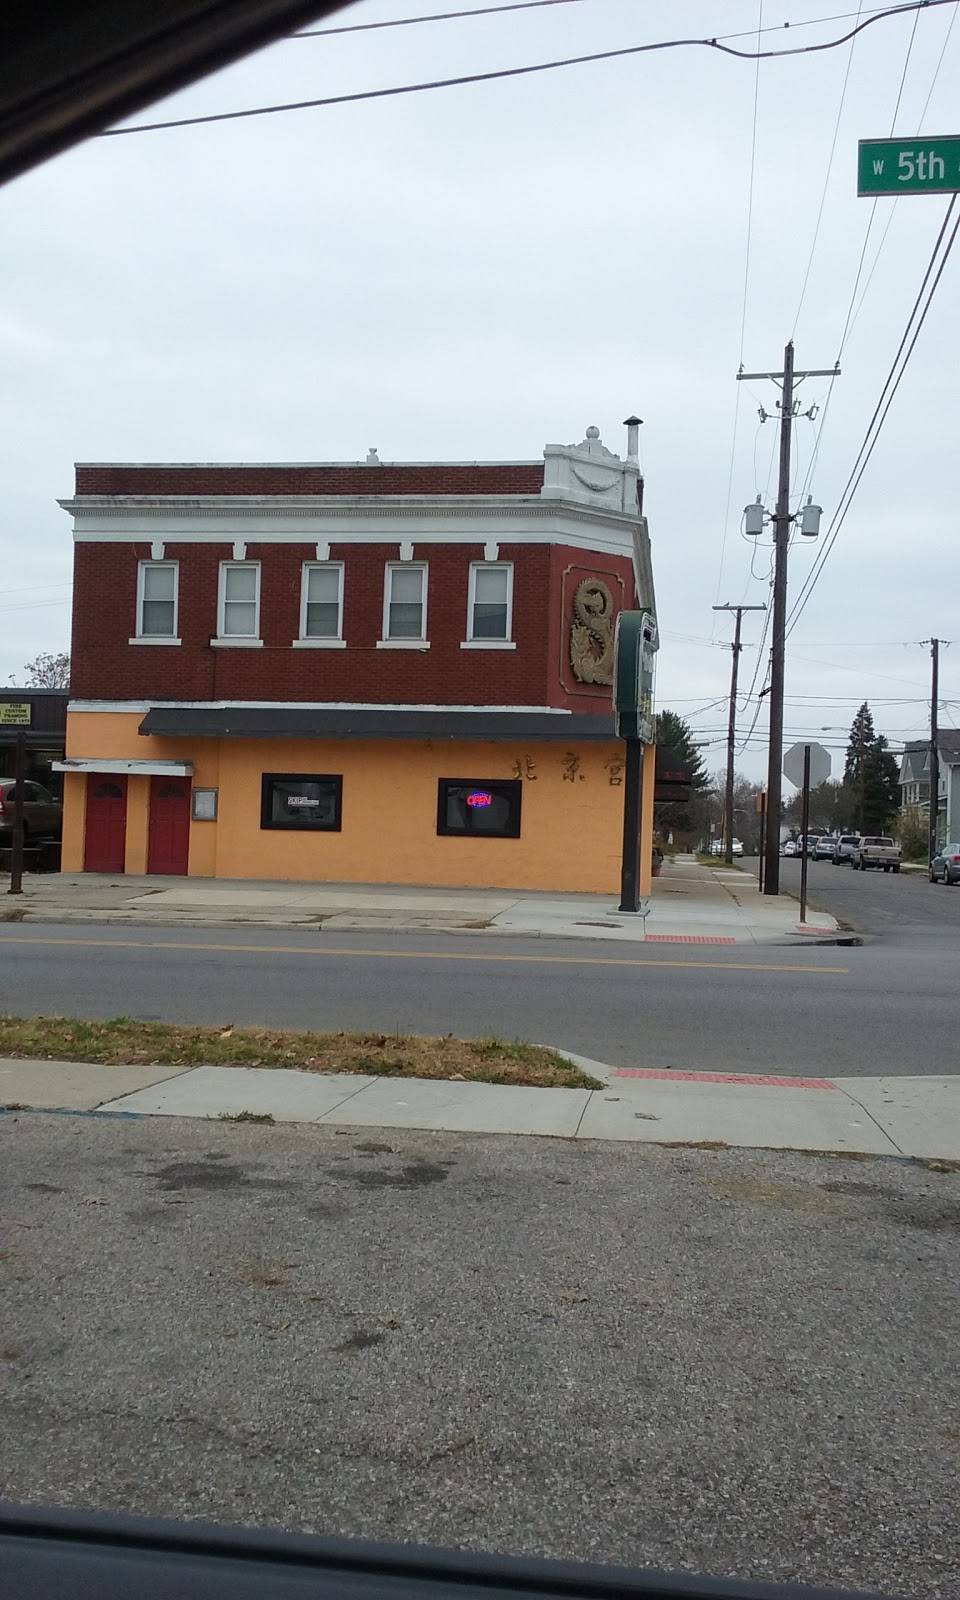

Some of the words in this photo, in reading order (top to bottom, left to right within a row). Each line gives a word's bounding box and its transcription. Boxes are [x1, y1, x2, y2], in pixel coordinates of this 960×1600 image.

[873, 160, 884, 175] W
[897, 151, 945, 181] 5th
[467, 793, 492, 807] OPEN
